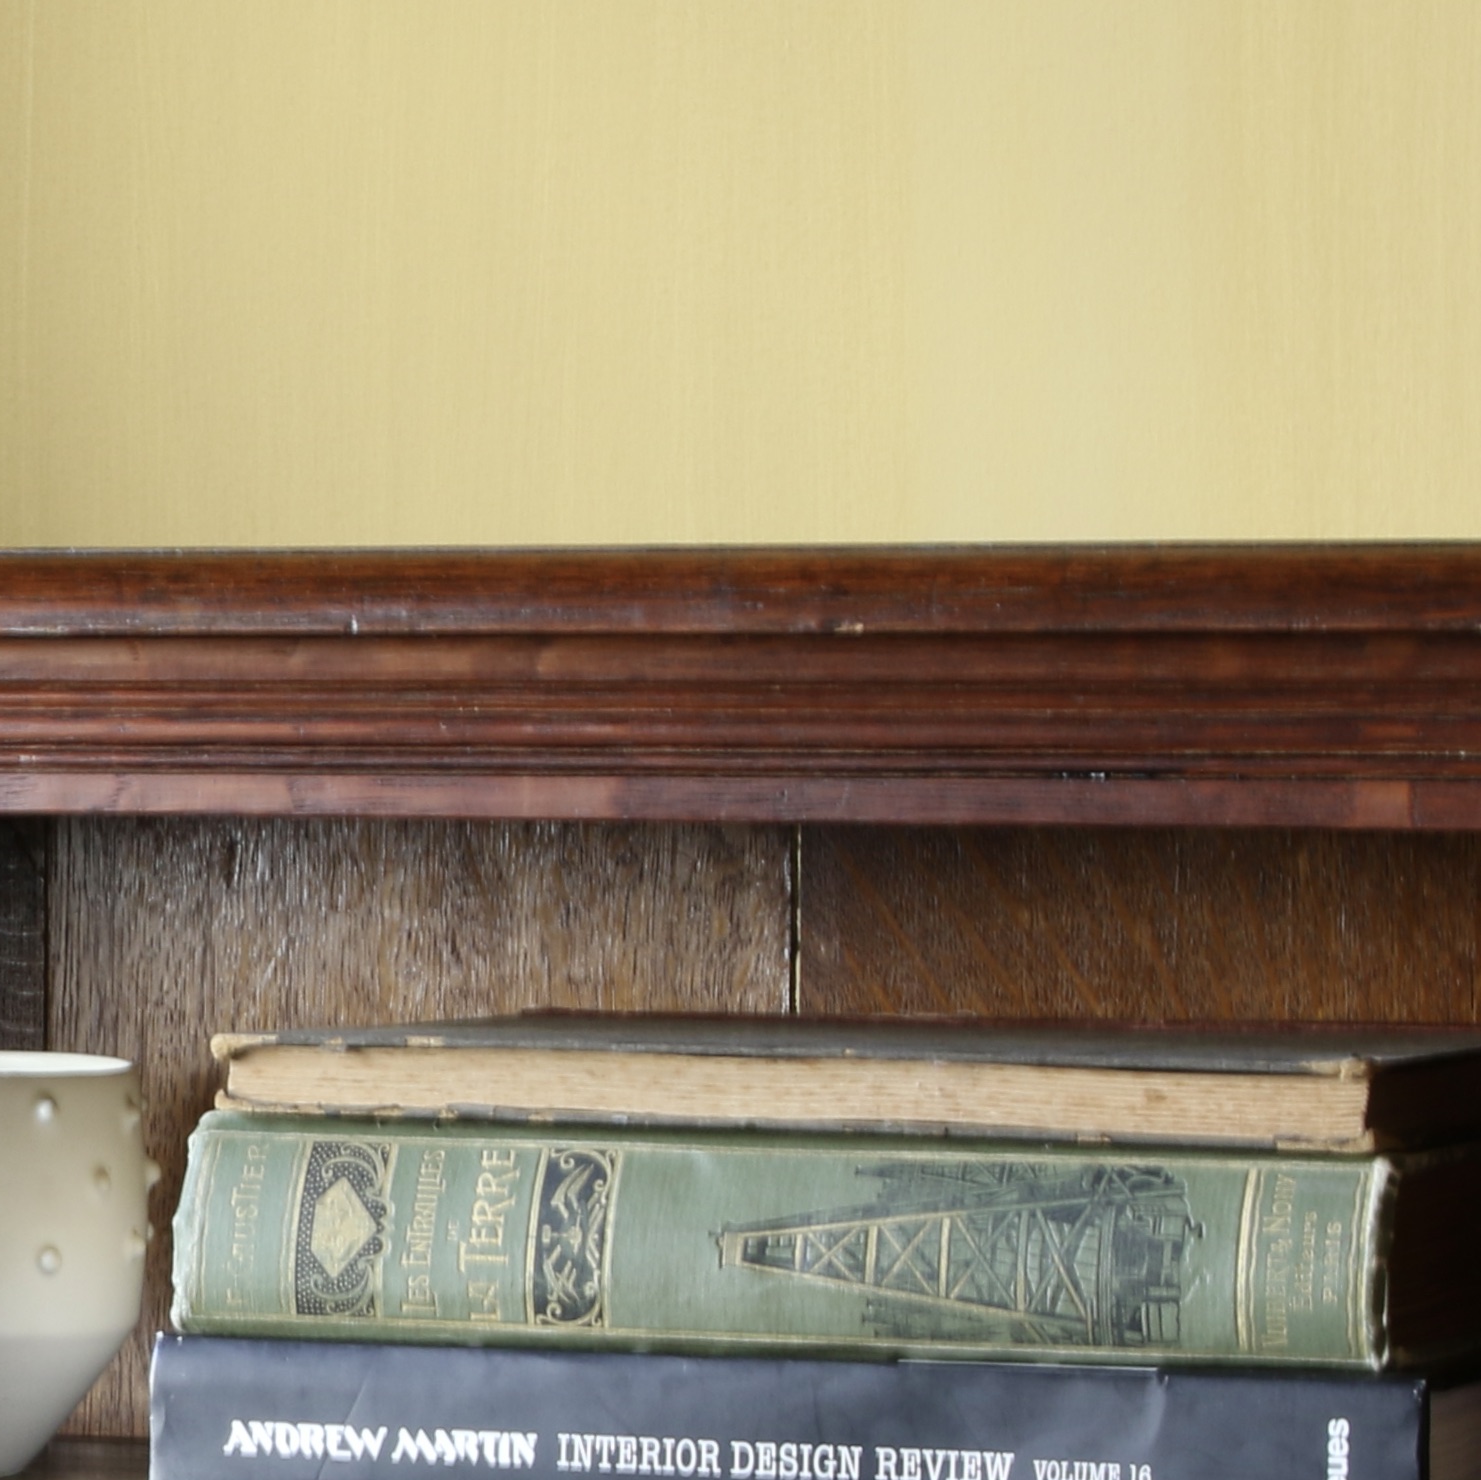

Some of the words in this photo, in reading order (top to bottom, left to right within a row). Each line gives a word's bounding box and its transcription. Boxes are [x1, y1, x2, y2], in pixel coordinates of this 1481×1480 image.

[401, 1149, 446, 1266] ENTRAILLES
[457, 1148, 520, 1271] TERRE
[465, 1279, 501, 1322] LA
[224, 1418, 386, 1460] ANDREW
[392, 1426, 538, 1469] MARTIN
[557, 1432, 721, 1476] INTERIOR
